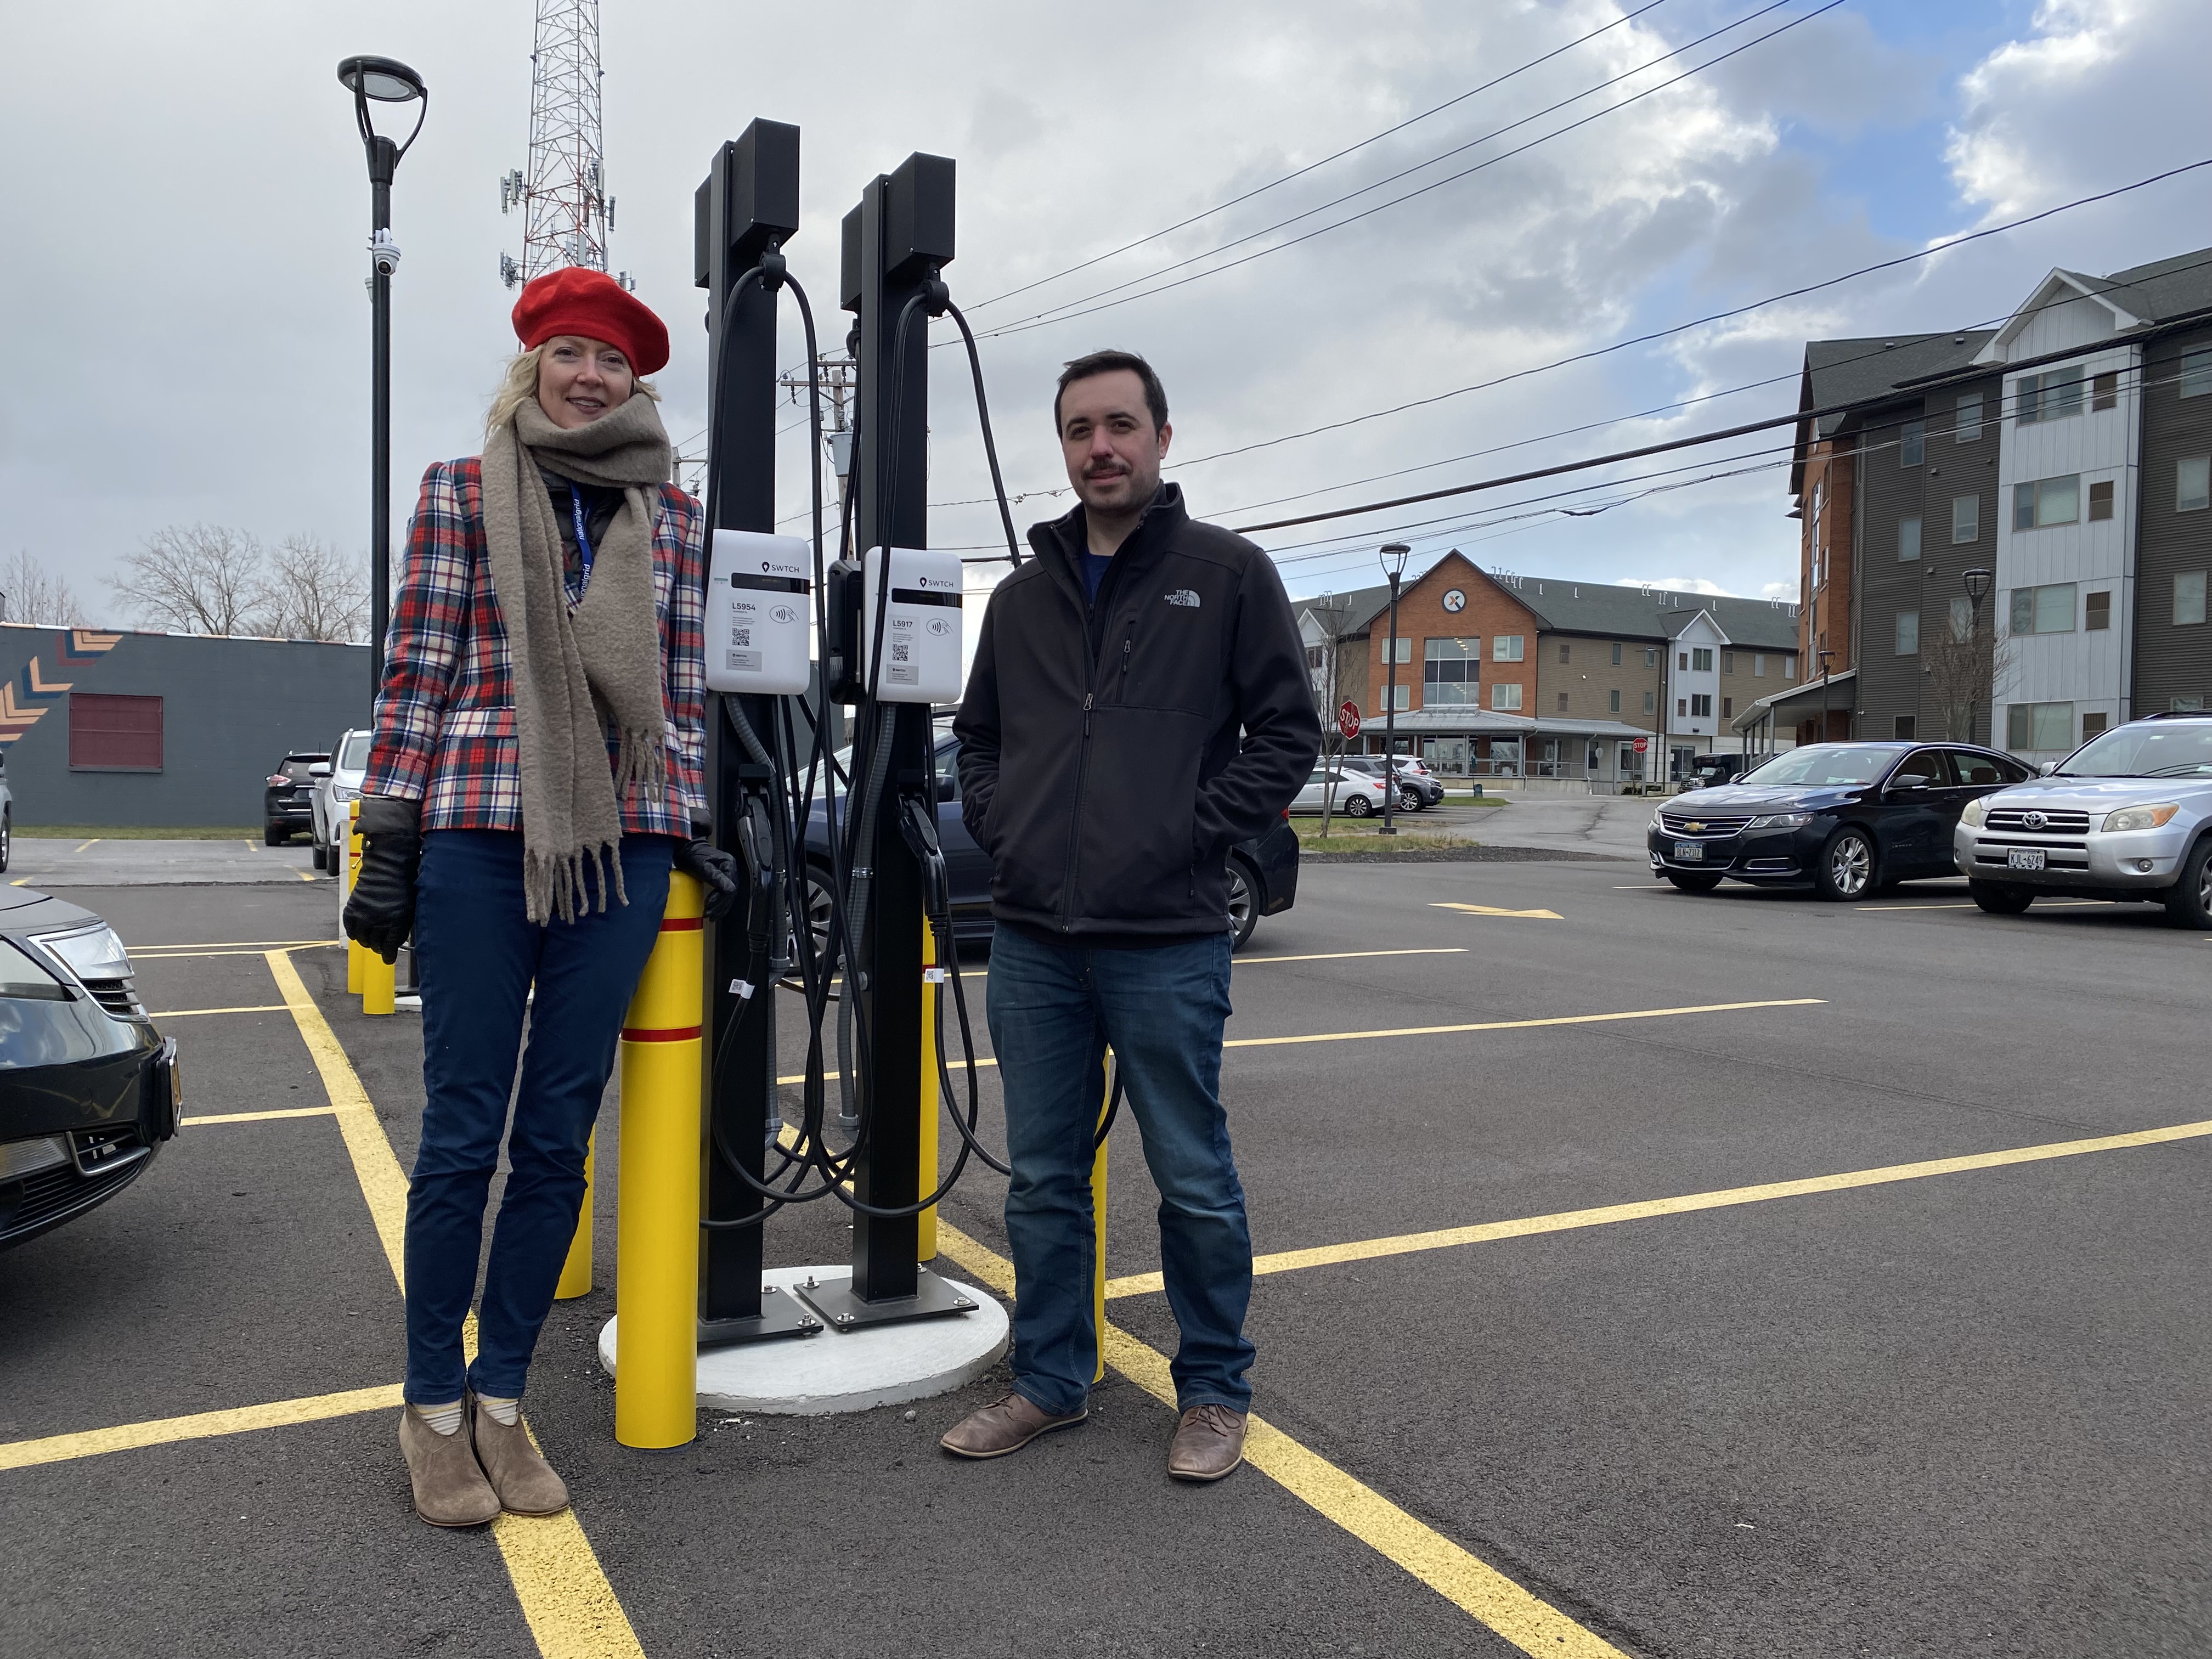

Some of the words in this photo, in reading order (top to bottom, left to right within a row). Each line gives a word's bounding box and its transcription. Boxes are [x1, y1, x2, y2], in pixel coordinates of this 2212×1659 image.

[771, 565, 799, 573] SWTCH
[928, 579, 953, 588] SWTCH
[732, 602, 755, 611] L5954
[1340, 708, 1359, 730] STOP
